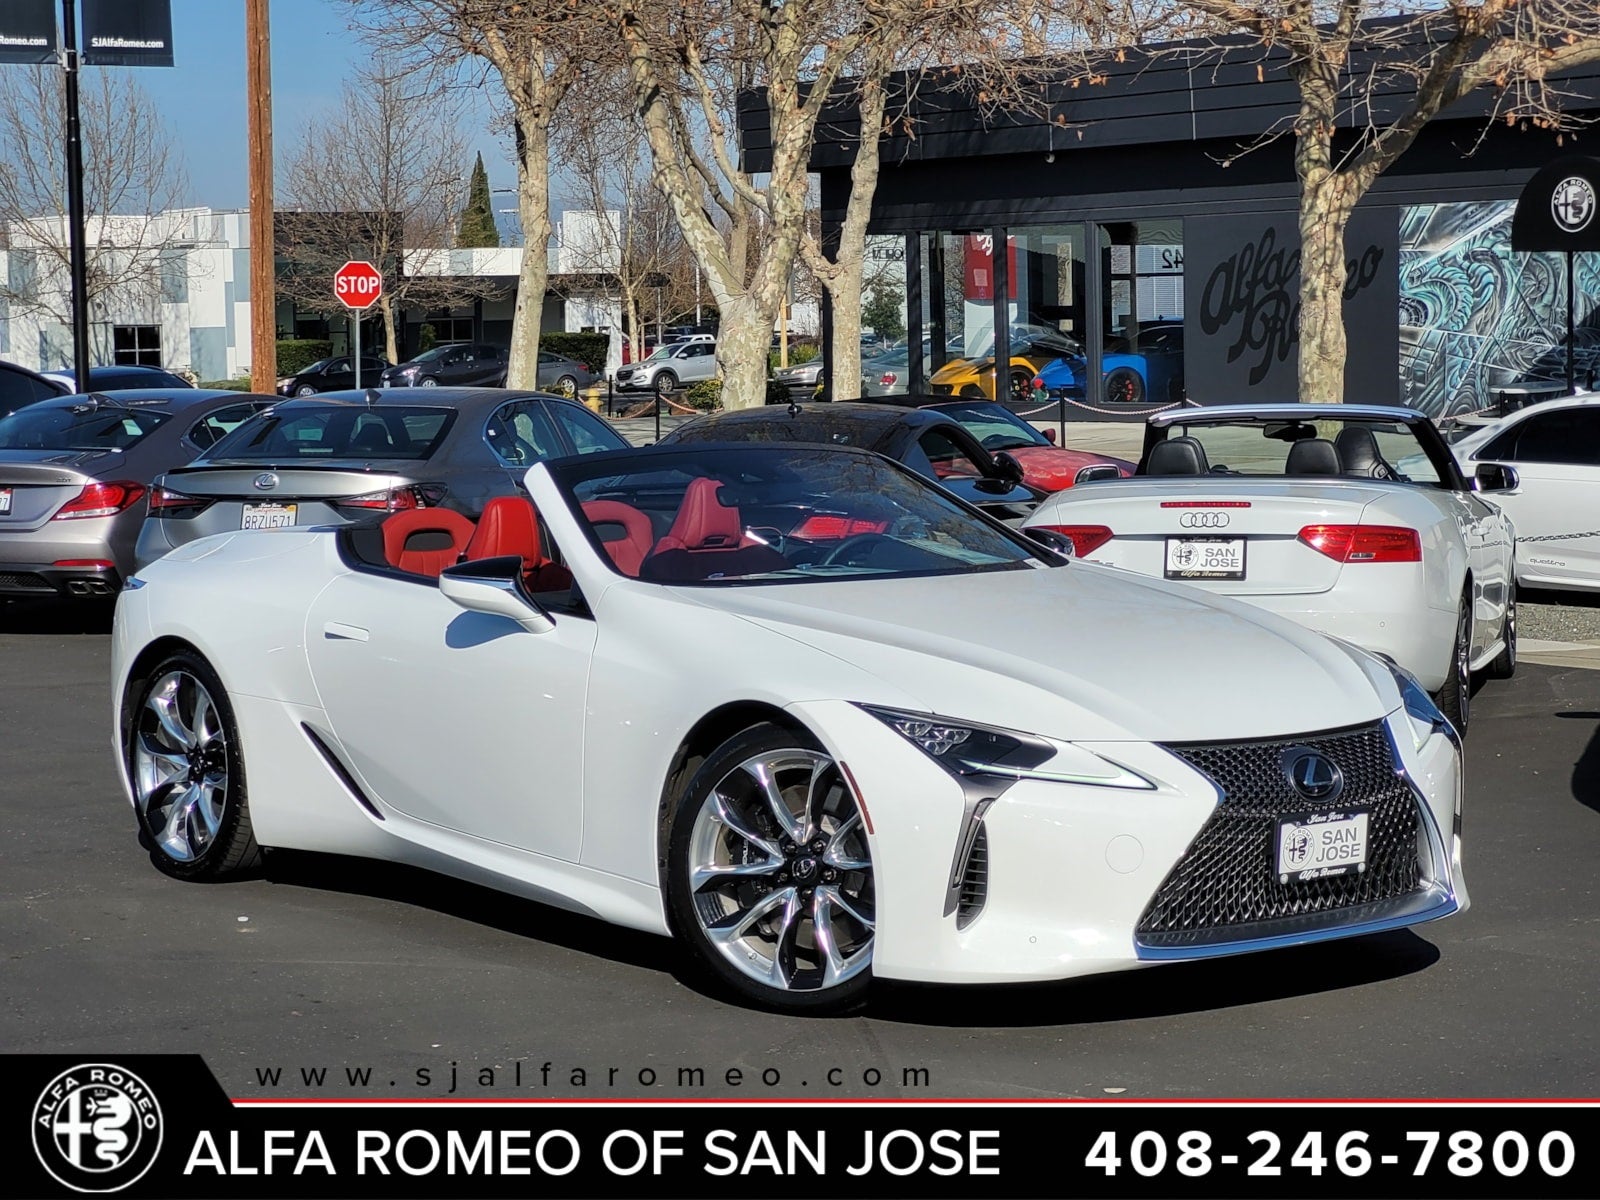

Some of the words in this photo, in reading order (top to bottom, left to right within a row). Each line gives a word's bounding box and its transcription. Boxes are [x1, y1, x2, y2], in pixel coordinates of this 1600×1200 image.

[91, 38, 164, 48] SJAlfaRomeo.com
[1570, 180, 1592, 204] ROMEO
[338, 276, 379, 293] STOP
[1205, 548, 1235, 557] SAN
[1200, 558, 1239, 568] JOSE
[1530, 558, 1566, 567] quattro
[1307, 813, 1327, 824] San
[1322, 827, 1357, 845] SAN
[1316, 843, 1361, 862] JOSE
[1299, 868, 1319, 880] Alfa
[1320, 867, 1348, 877] Romeo
